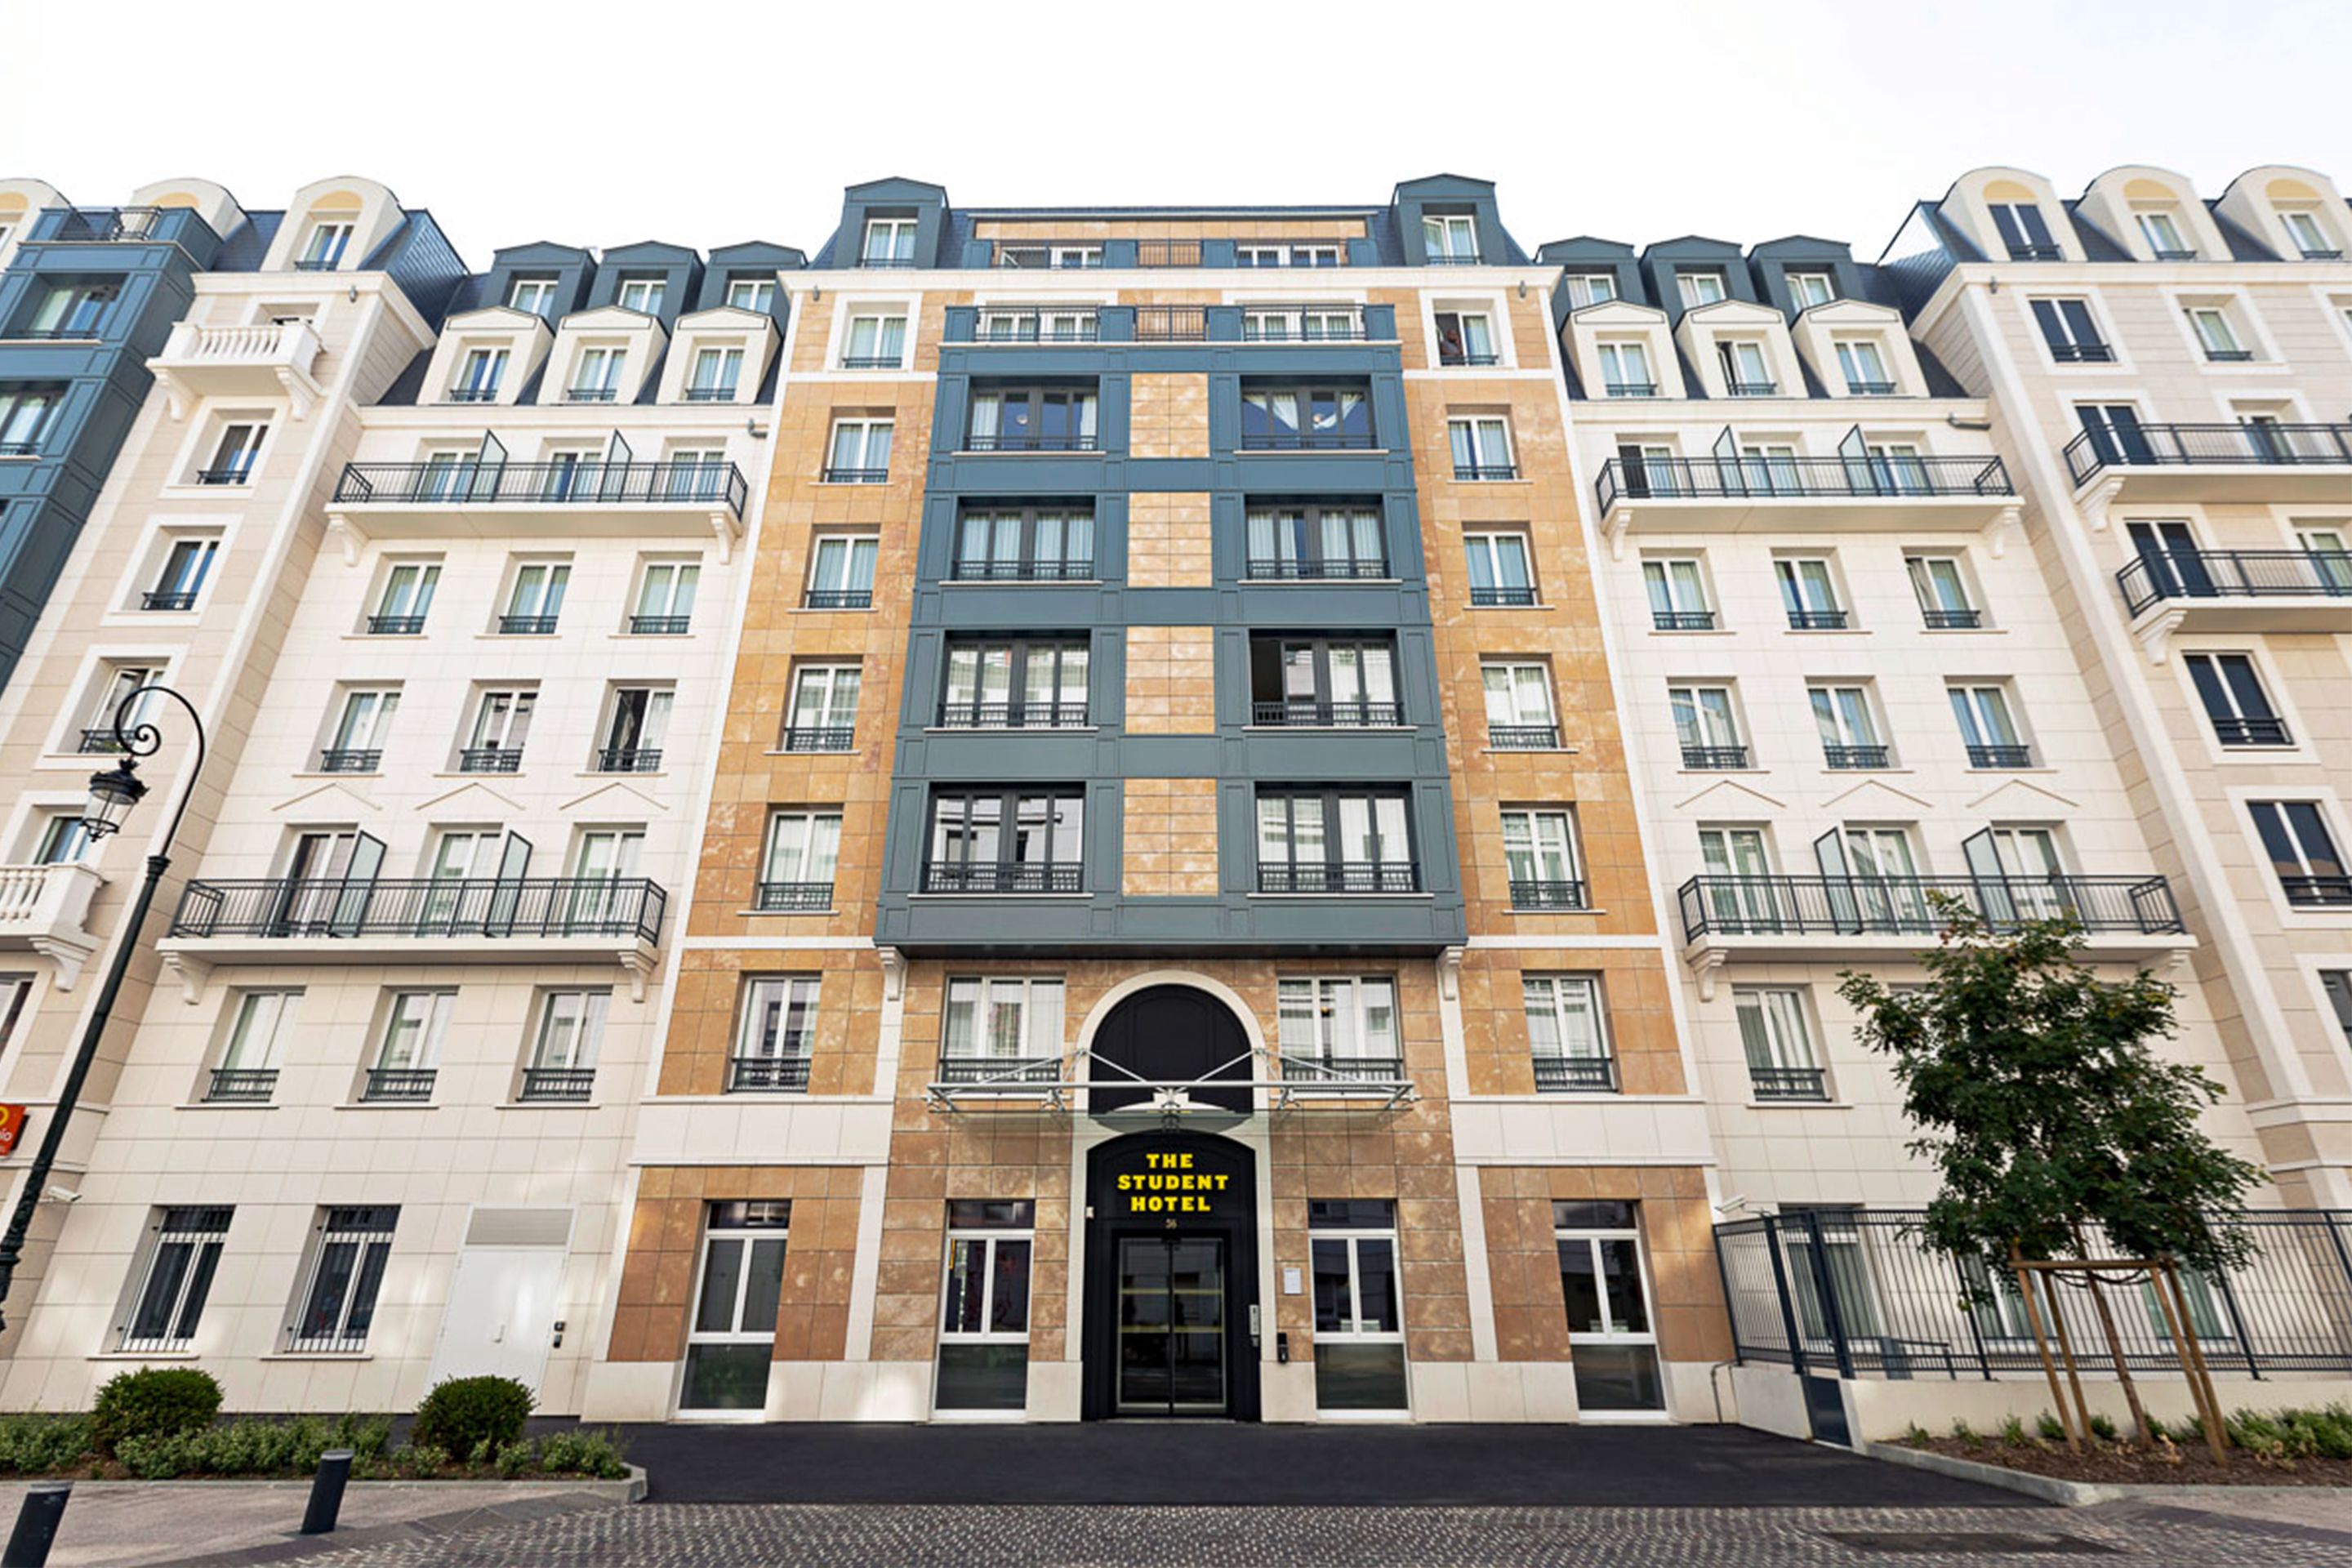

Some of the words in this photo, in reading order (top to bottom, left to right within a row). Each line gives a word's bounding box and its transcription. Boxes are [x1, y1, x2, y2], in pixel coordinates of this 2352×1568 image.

[1146, 1153, 1193, 1169] THE
[1117, 1174, 1229, 1190] STUDENT
[1130, 1196, 1211, 1212] HOTEL
